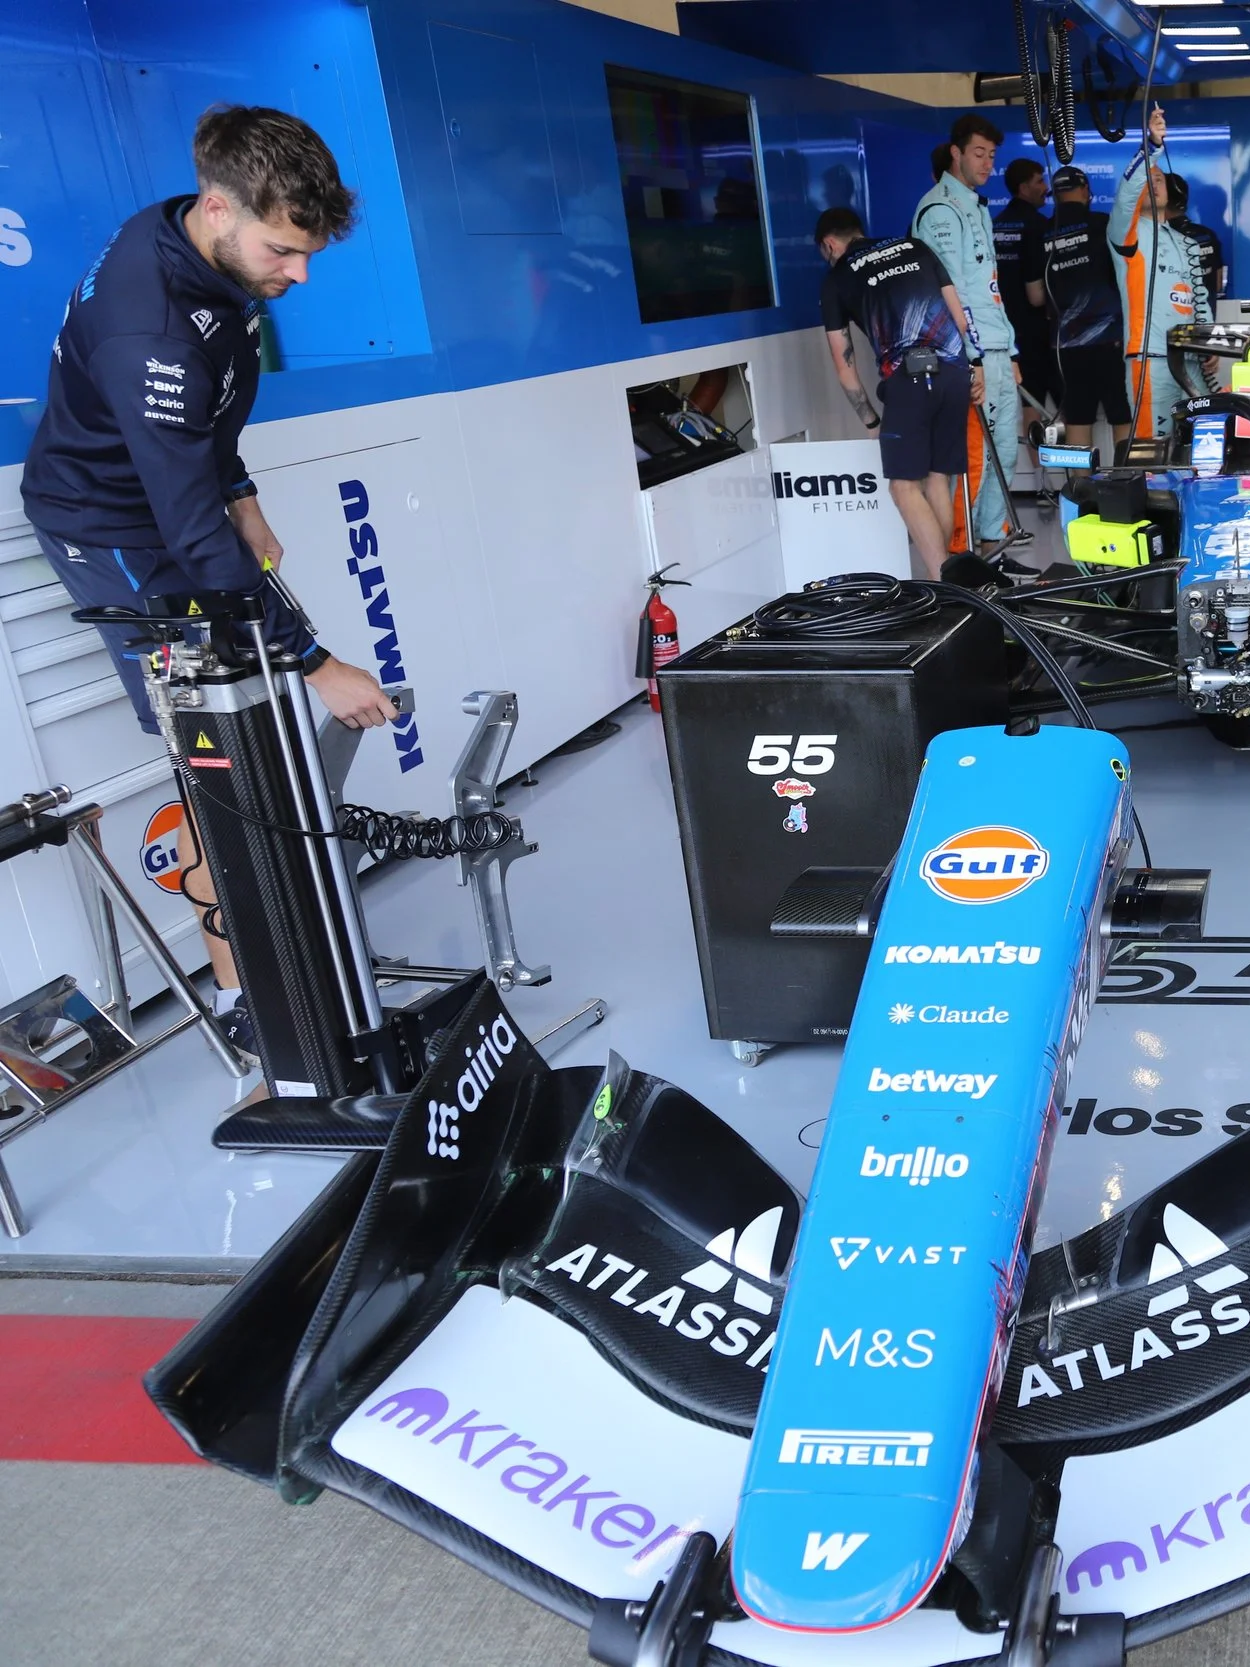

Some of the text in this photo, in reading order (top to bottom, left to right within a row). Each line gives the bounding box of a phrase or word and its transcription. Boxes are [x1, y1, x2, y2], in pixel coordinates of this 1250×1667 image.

[851, 241, 914, 271] Williams
[882, 253, 901, 263] TEAM
[1060, 256, 1090, 269] BARCLAYS
[877, 262, 920, 281] BARCLAYS
[146, 361, 185, 375] WILKINSON
[154, 381, 185, 395] BNY
[158, 399, 185, 409] airia
[1193, 398, 1210, 408] airia
[144, 411, 185, 423] nuveen
[1056, 455, 1089, 464] BARCLAYS
[812, 500, 879, 513] F1 TEAM
[338, 479, 425, 774] KMATSU
[747, 734, 838, 776] 55
[929, 852, 1041, 874] Gulf
[884, 941, 1041, 965] KOMATSU
[918, 1005, 1010, 1024] Claude
[457, 1012, 518, 1113] airia
[867, 1067, 998, 1100] betway
[1062, 1097, 1203, 1138] los
[859, 1145, 970, 1187] brillio
[874, 1246, 967, 1265] VAST
[545, 1243, 779, 1374] ATLASSI
[815, 1327, 936, 1369] M&S
[778, 1428, 934, 1467] PIRELLI
[801, 1531, 870, 1571] W
